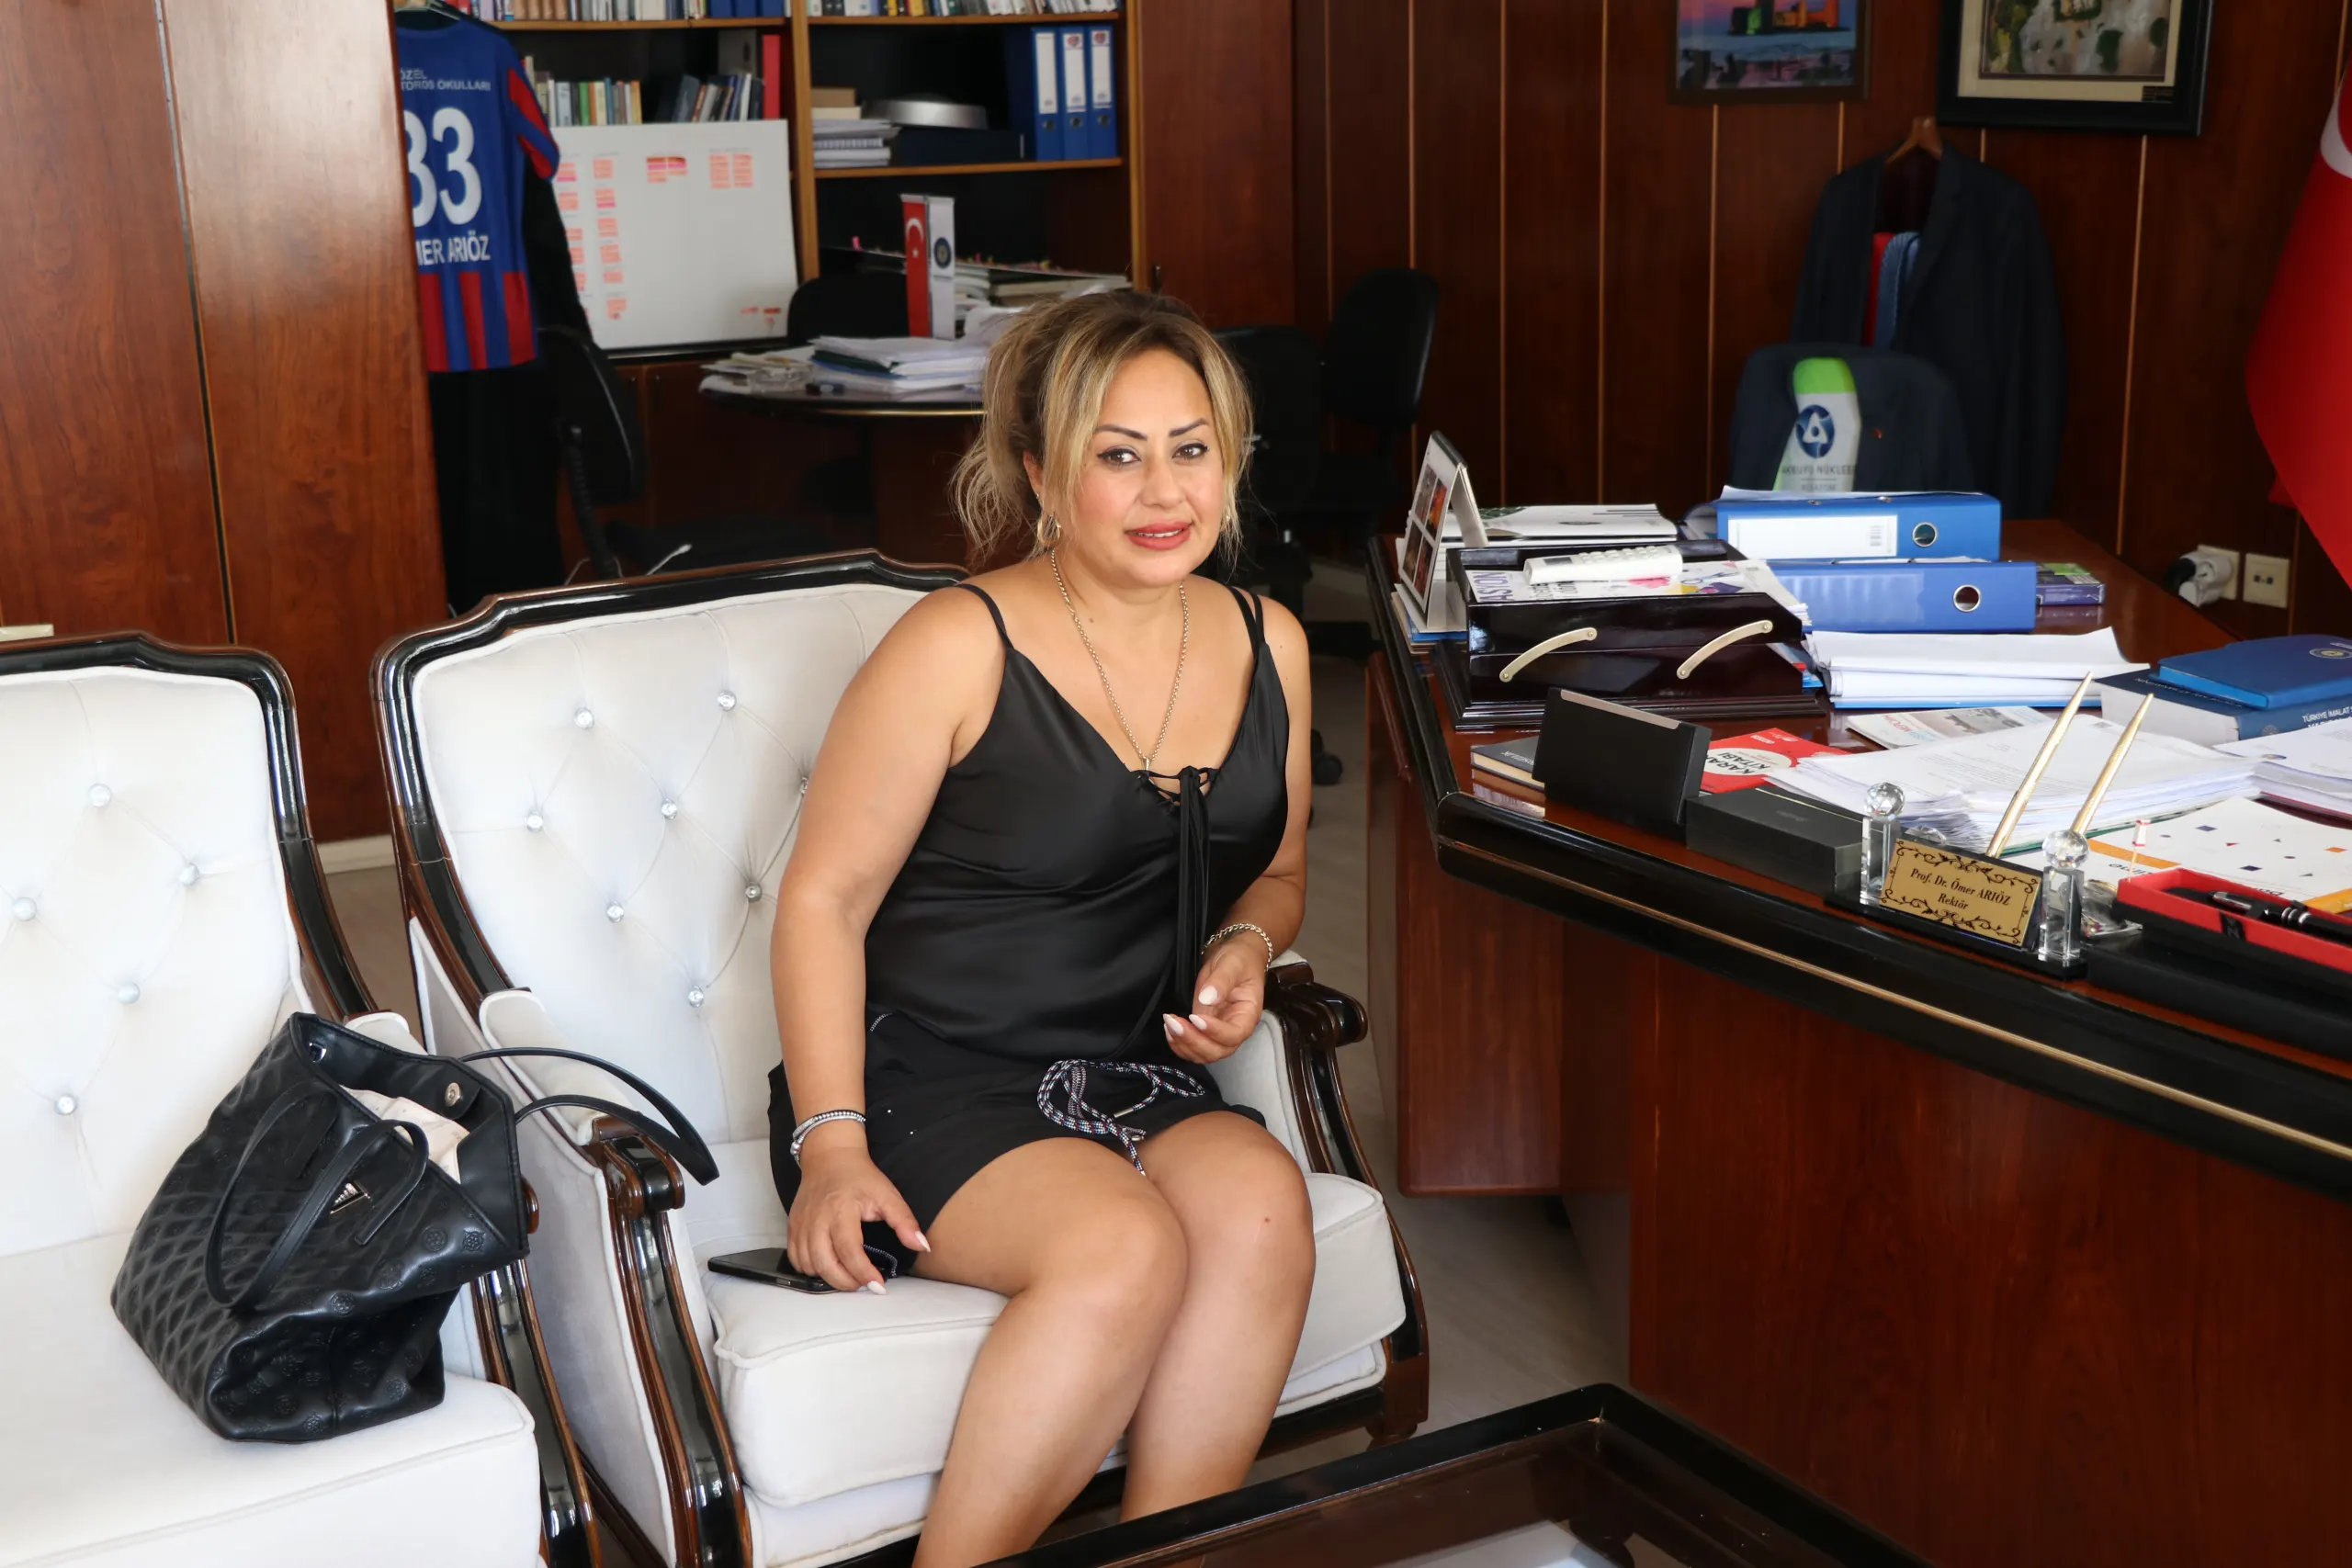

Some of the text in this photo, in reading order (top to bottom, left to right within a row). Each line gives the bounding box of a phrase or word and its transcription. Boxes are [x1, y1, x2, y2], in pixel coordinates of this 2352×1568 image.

[436, 79, 492, 91] OKULLARI
[447, 230, 491, 264] ARIÖZ
[1910, 868, 2011, 906] Prof. Dr. Ömer ARIÖZ
[1938, 893, 1969, 910] Rektör
